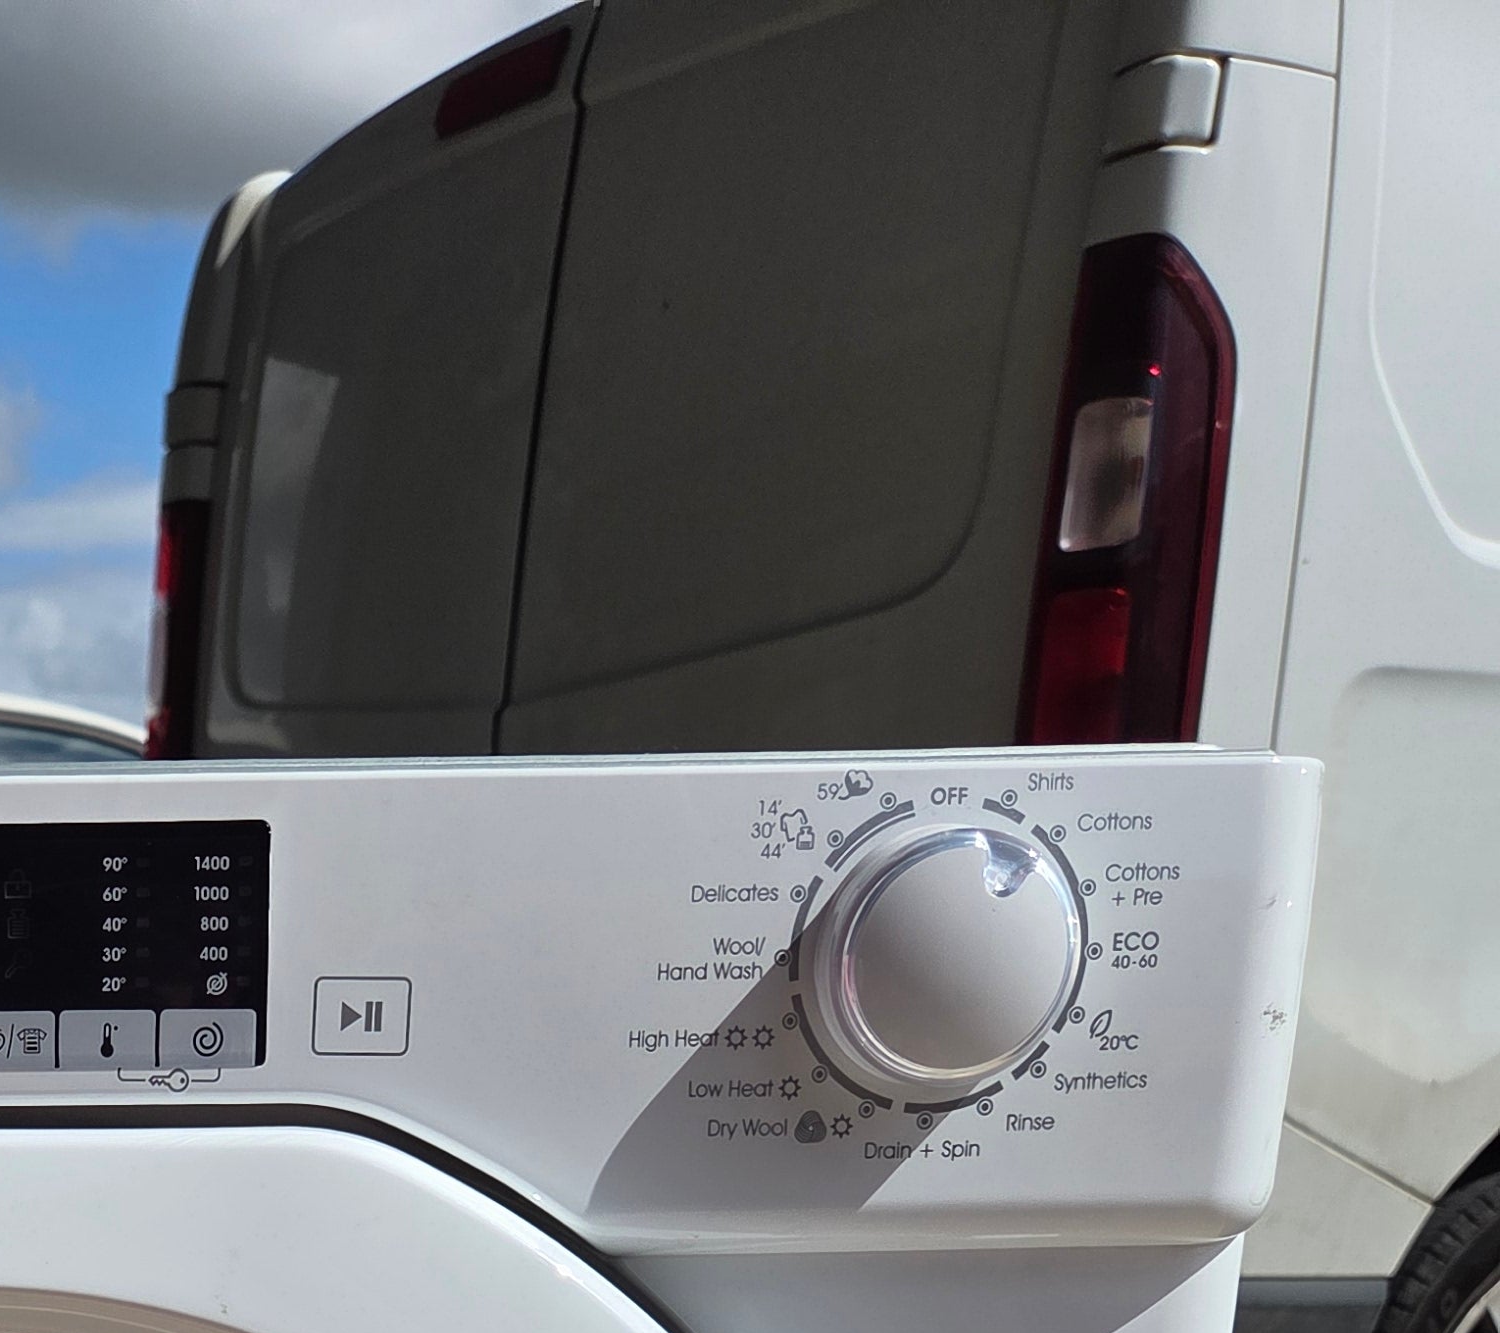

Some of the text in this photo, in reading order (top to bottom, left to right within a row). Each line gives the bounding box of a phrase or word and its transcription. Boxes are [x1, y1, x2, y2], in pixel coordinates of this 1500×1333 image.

[1028, 772, 1074, 791] Shirts
[930, 787, 969, 805] OFF
[1077, 813, 1152, 832] Cottons
[194, 855, 231, 871] 1400
[1105, 863, 1180, 882] Cottons
[193, 886, 230, 901] 1000
[691, 885, 779, 903] Delicates
[1133, 888, 1163, 906] Pre
[200, 916, 229, 931] 800
[713, 937, 766, 956] Wool/
[1112, 931, 1160, 951] ECO
[199, 946, 228, 961] 400
[1111, 954, 1158, 969] 40-60
[657, 963, 763, 981] Hand Wash
[628, 1030, 720, 1052] High Heat
[688, 1080, 774, 1098] Low Heat
[1054, 1071, 1148, 1094] Synthetics
[707, 1119, 788, 1140] Dry Wool
[1006, 1113, 1055, 1132] Rinse
[864, 1141, 912, 1159] Drain
[941, 1140, 980, 1161] Spin
